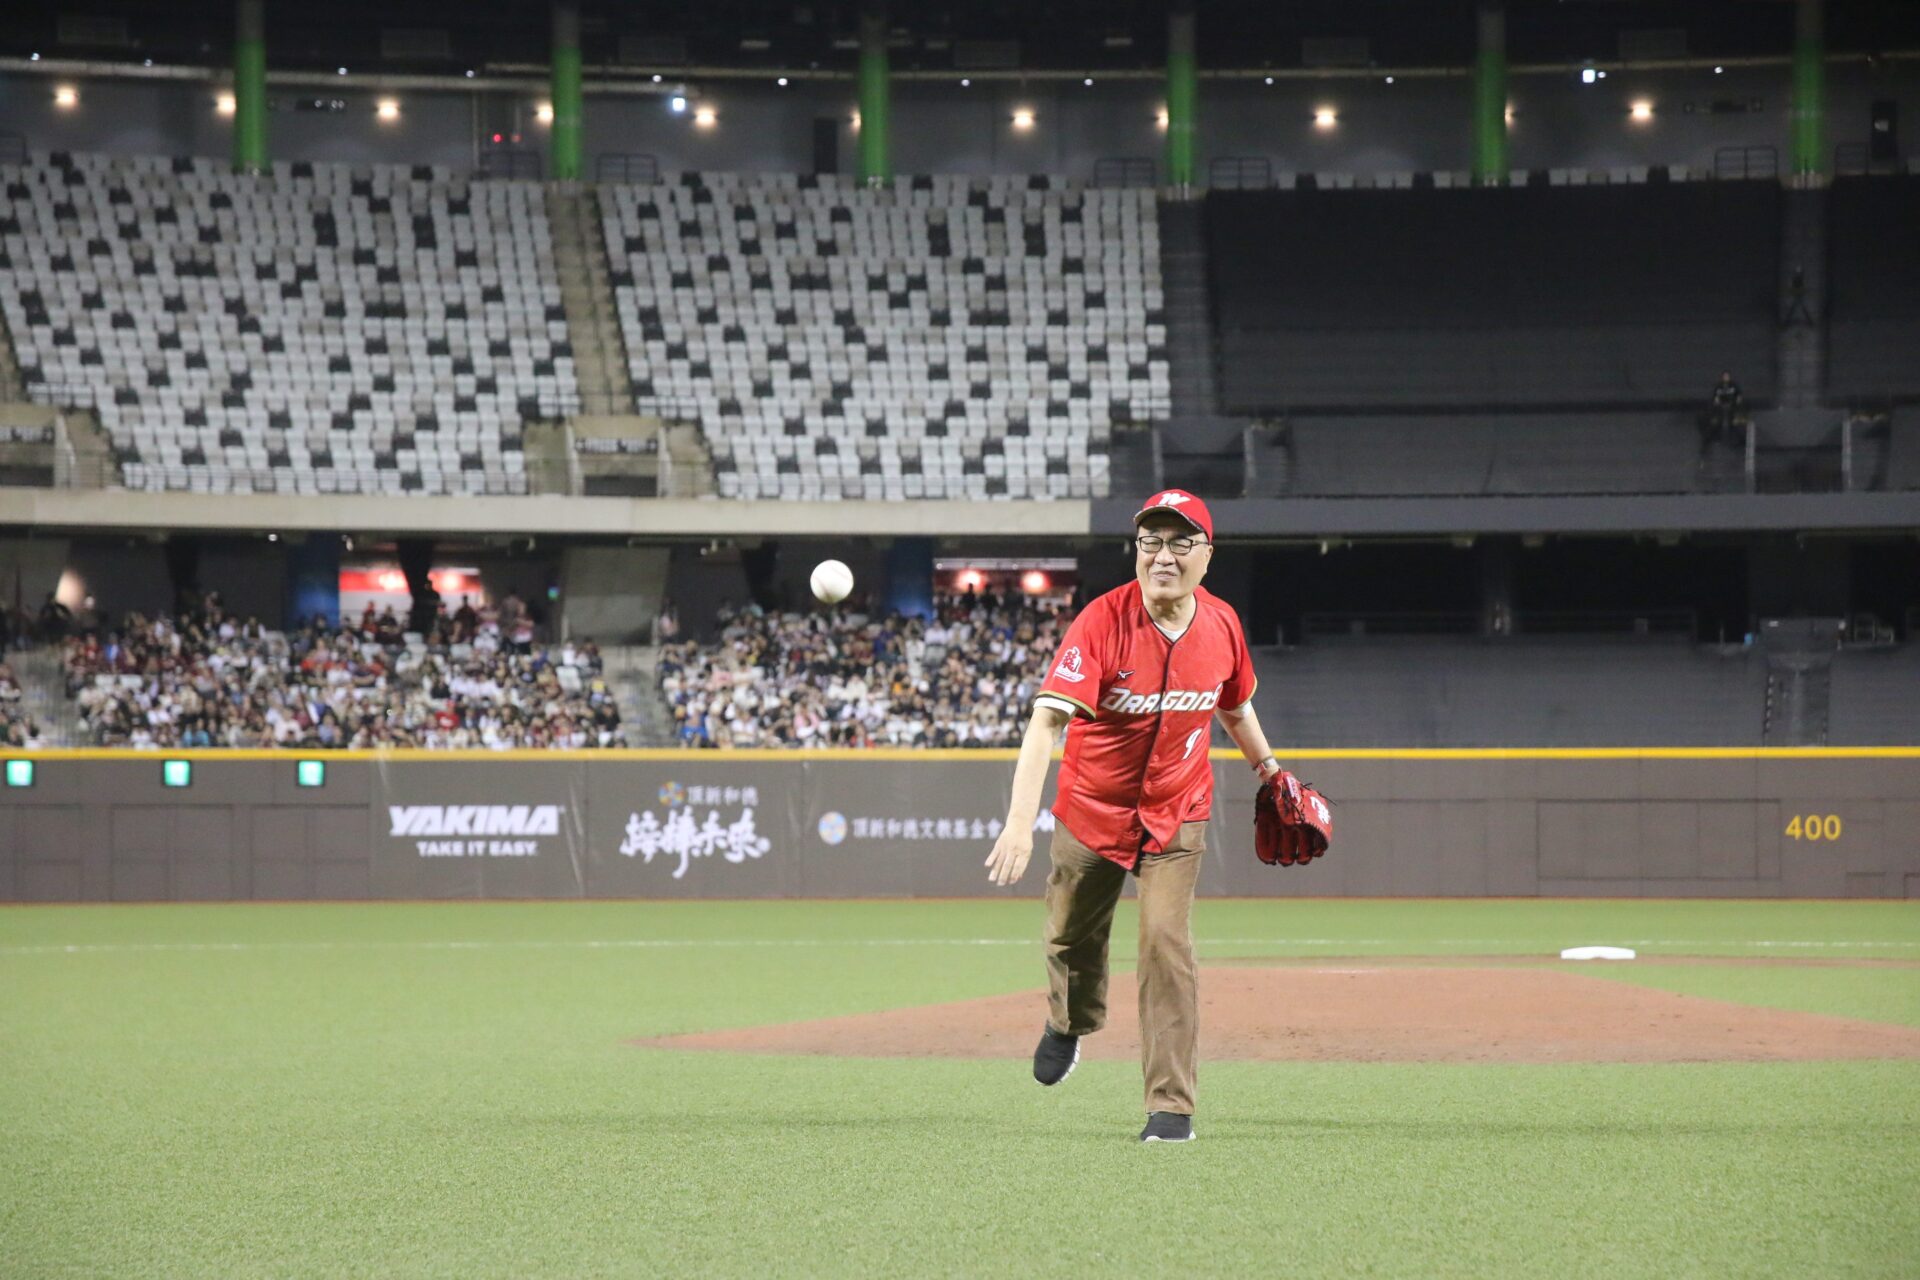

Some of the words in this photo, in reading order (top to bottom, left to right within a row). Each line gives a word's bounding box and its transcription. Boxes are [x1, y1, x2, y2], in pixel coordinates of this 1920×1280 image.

[1100, 682, 1223, 714] DRAGONS
[389, 805, 559, 836] YAKIMA
[1785, 814, 1842, 841] 400
[416, 841, 464, 857] TAKE
[468, 841, 487, 857] IT
